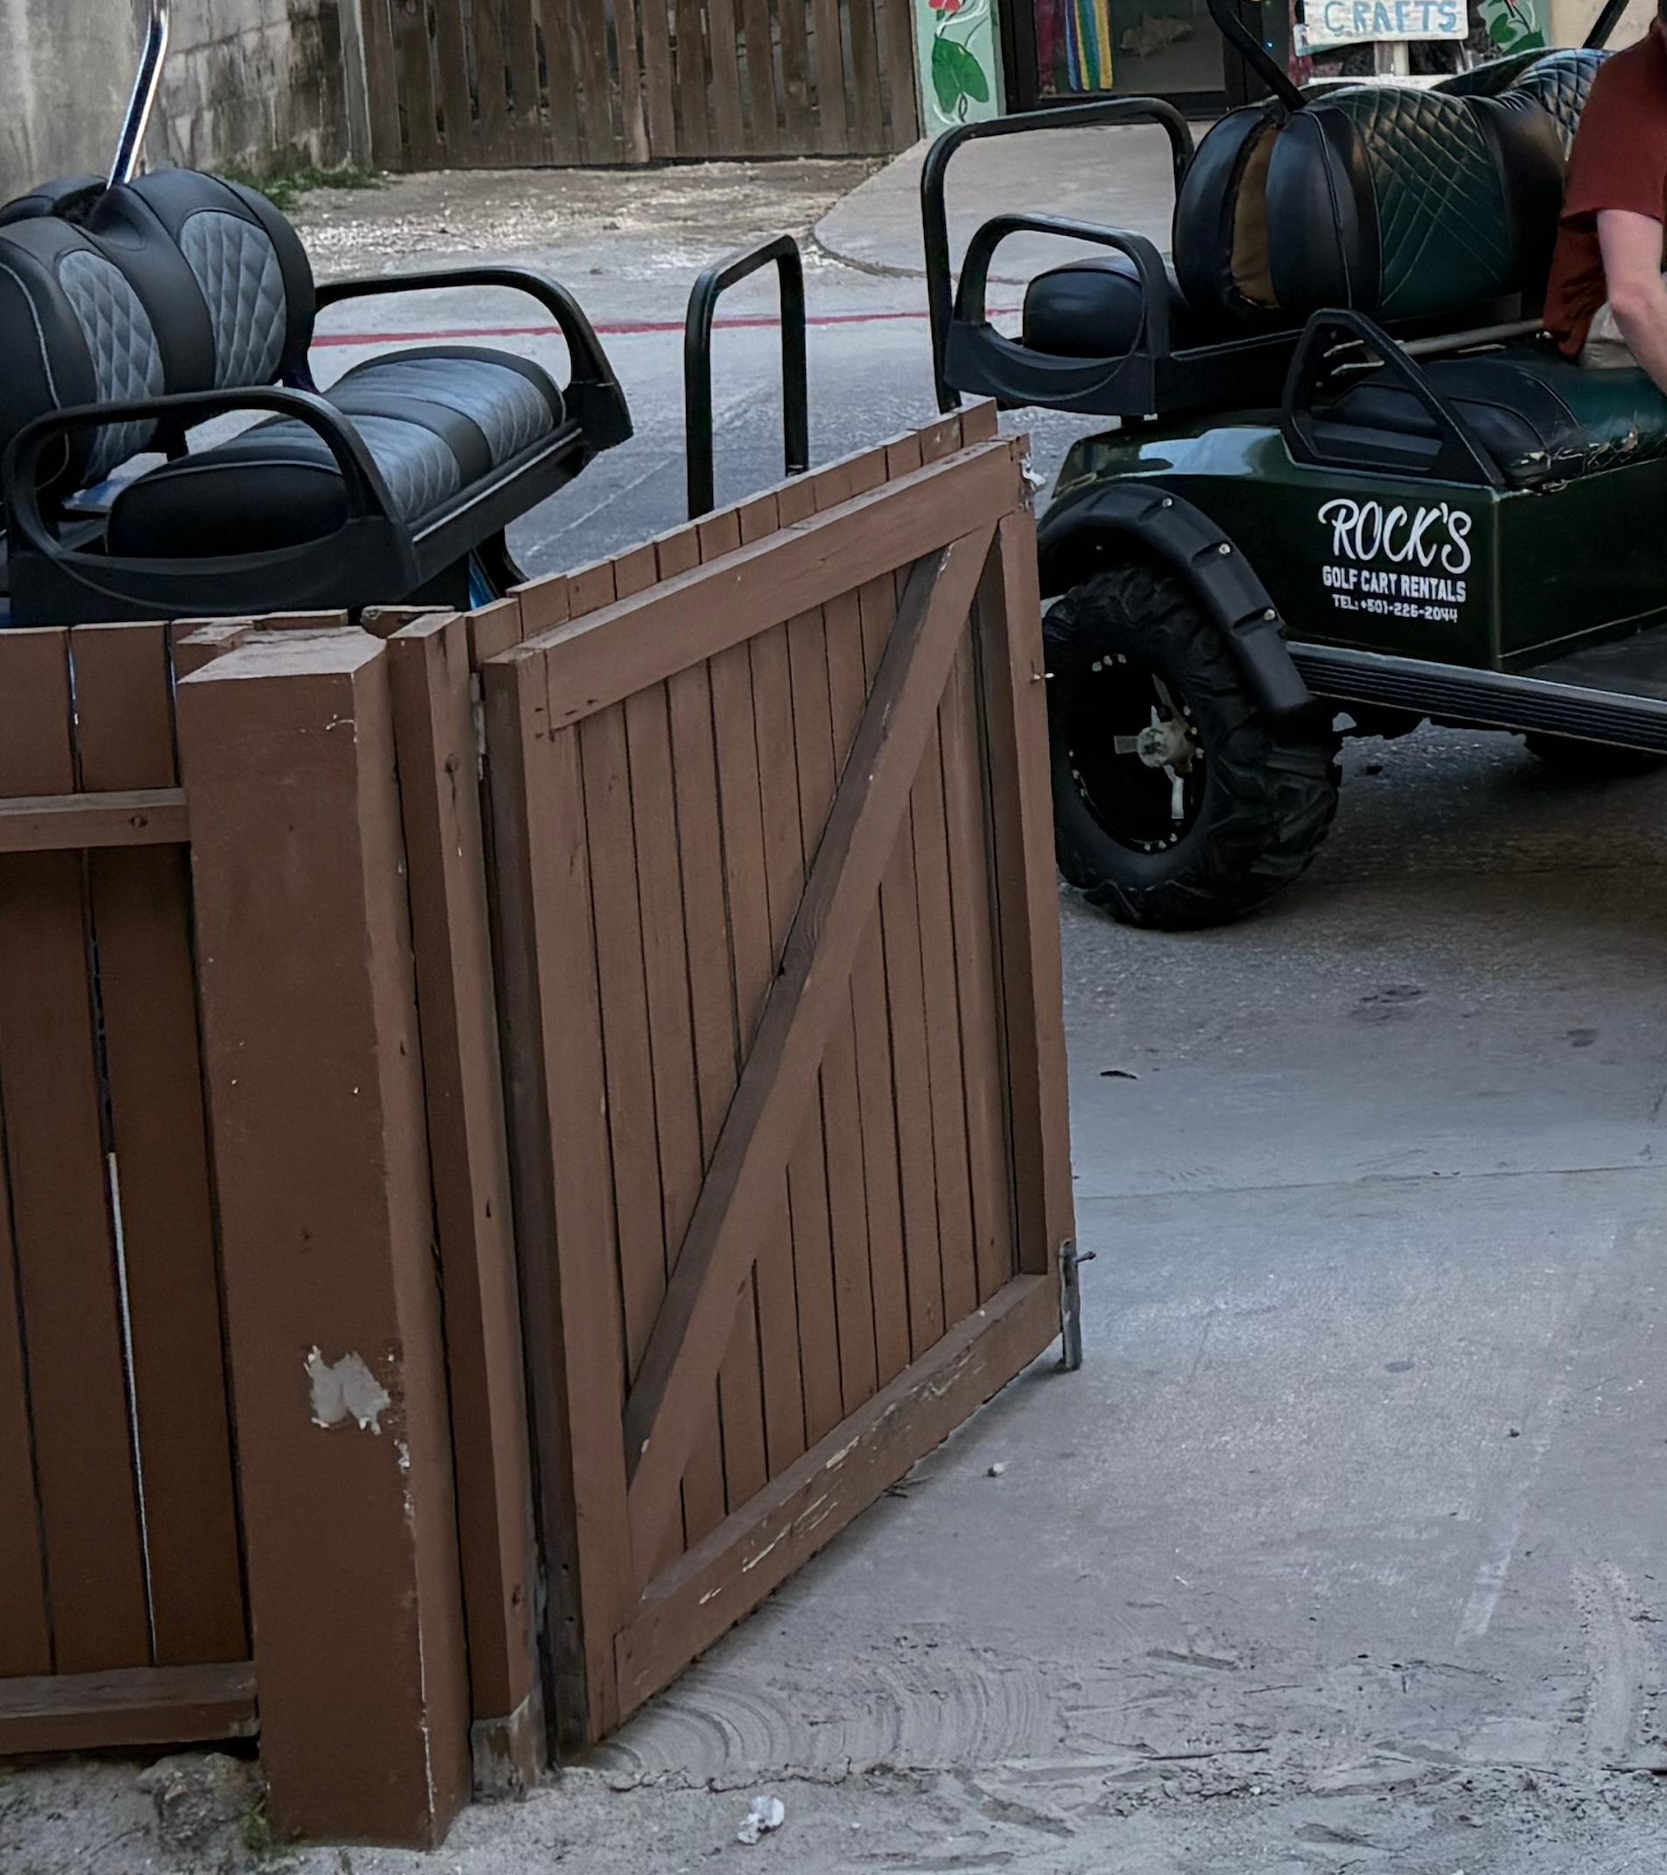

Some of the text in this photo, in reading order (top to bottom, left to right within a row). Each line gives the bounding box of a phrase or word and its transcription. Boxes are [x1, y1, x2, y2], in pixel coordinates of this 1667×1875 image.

[1323, 0, 1457, 33] CRAFTS
[1317, 498, 1473, 575] ROCK'S
[1322, 565, 1467, 603] GOLF CART RENTALS
